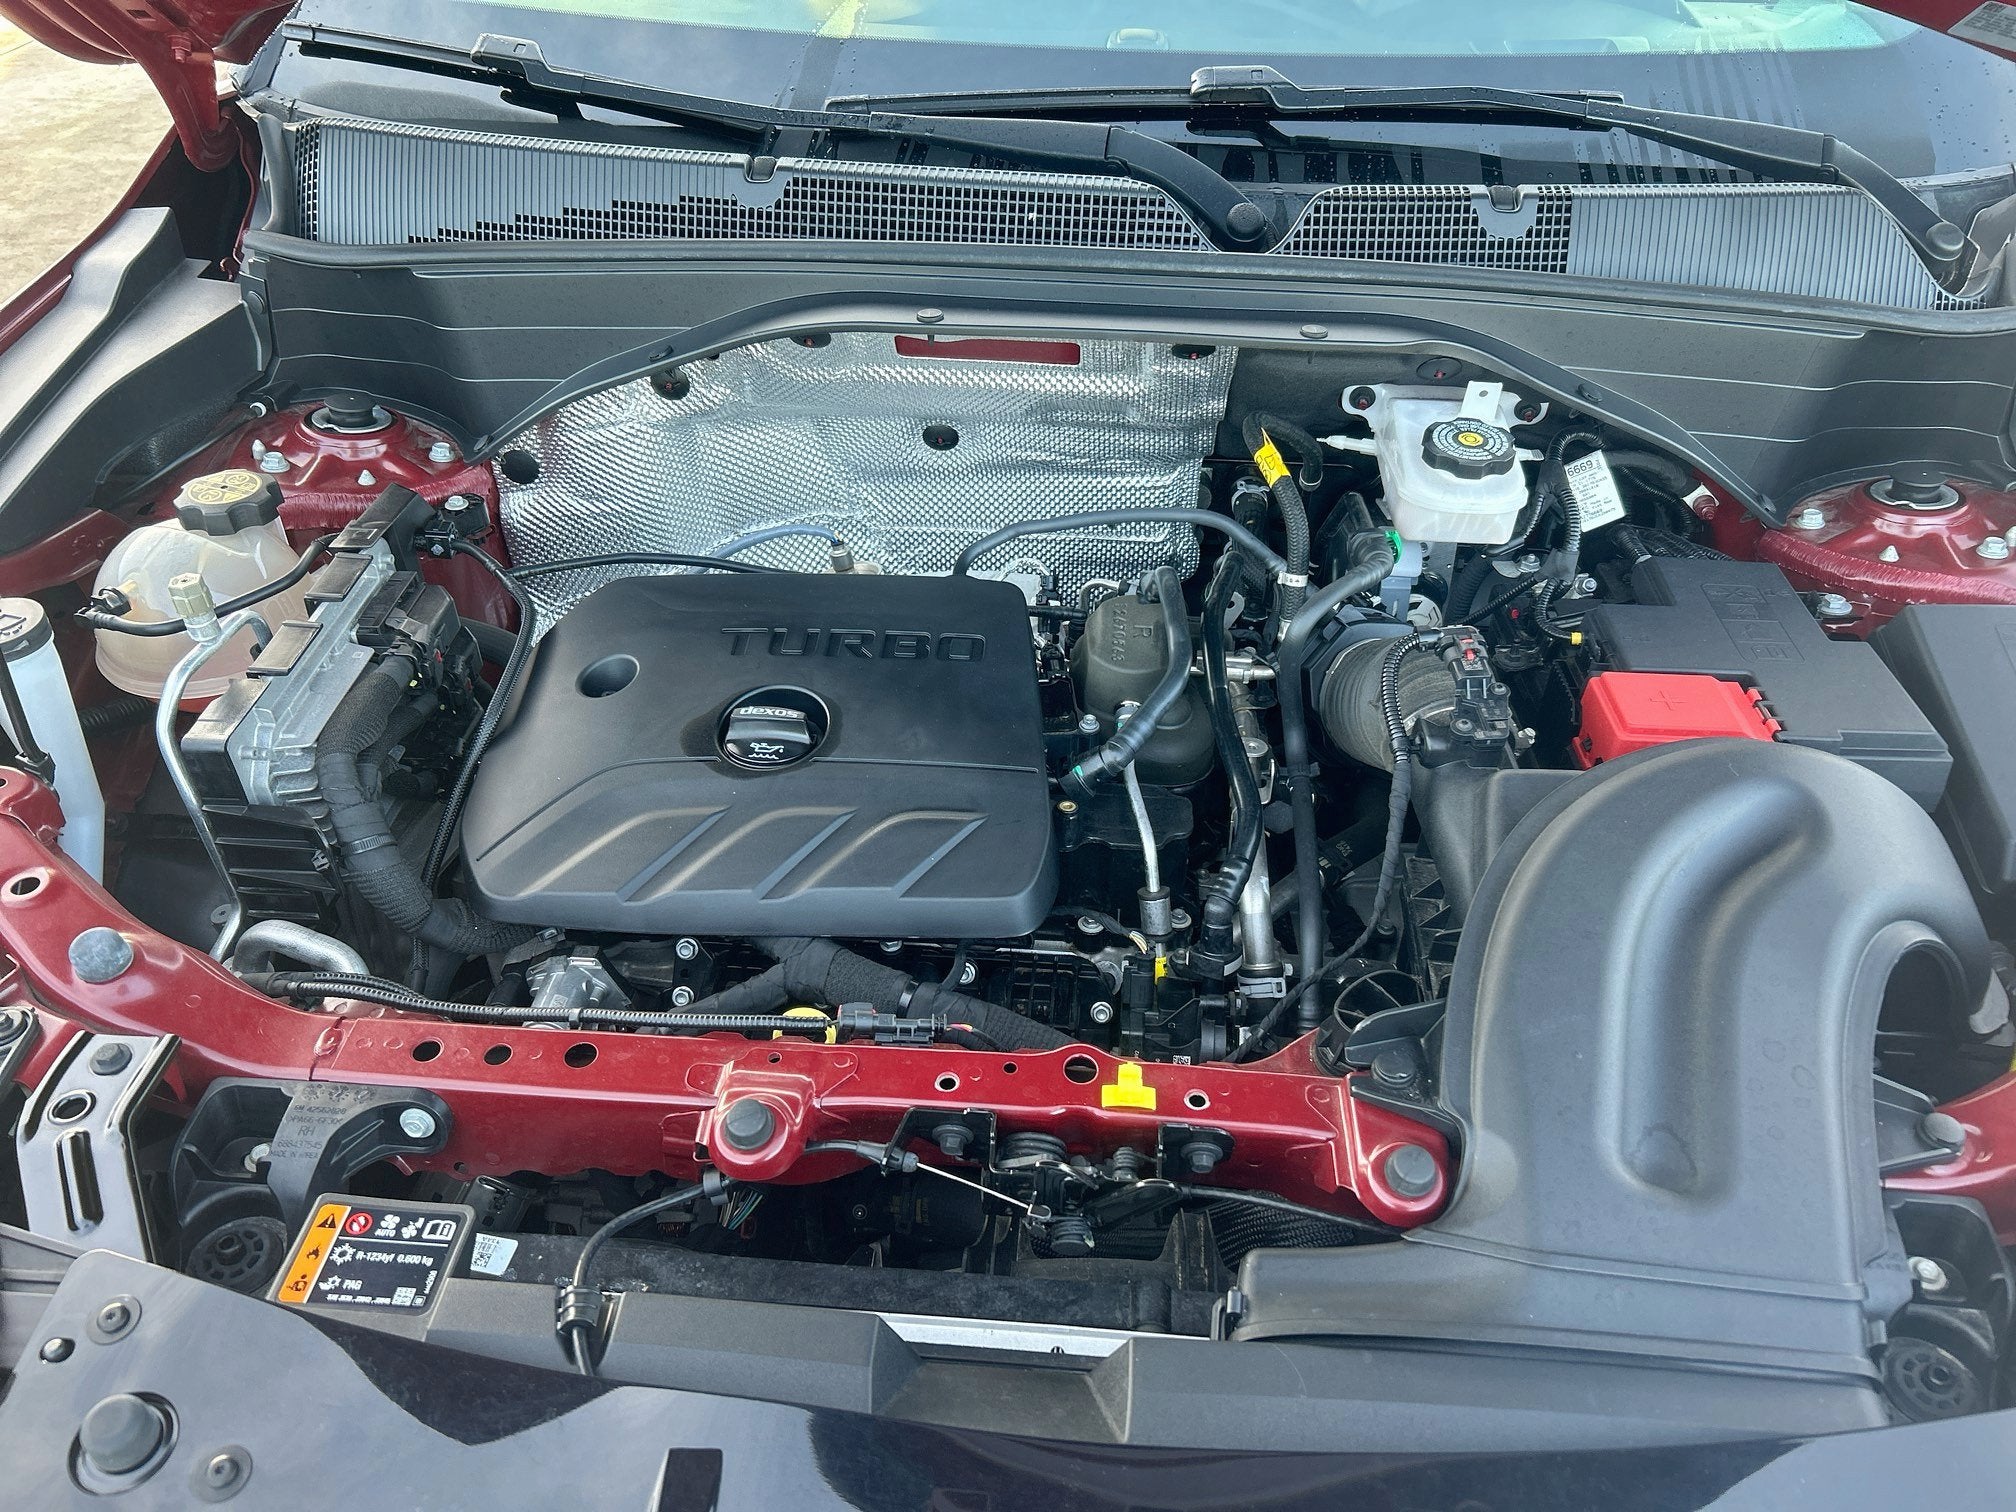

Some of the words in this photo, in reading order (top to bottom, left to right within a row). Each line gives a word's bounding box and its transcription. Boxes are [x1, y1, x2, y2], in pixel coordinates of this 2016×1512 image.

[1567, 459, 1594, 477] 6669
[1133, 624, 1153, 638] R
[721, 627, 986, 662] TURBO
[739, 705, 799, 719] dexos
[297, 1125, 316, 1136] RH
[374, 1228, 397, 1238] AUTO
[355, 1250, 395, 1264] R-1234yf
[396, 1253, 421, 1264] 0.600
[421, 1255, 434, 1267] kg
[342, 1279, 363, 1291] PAG
